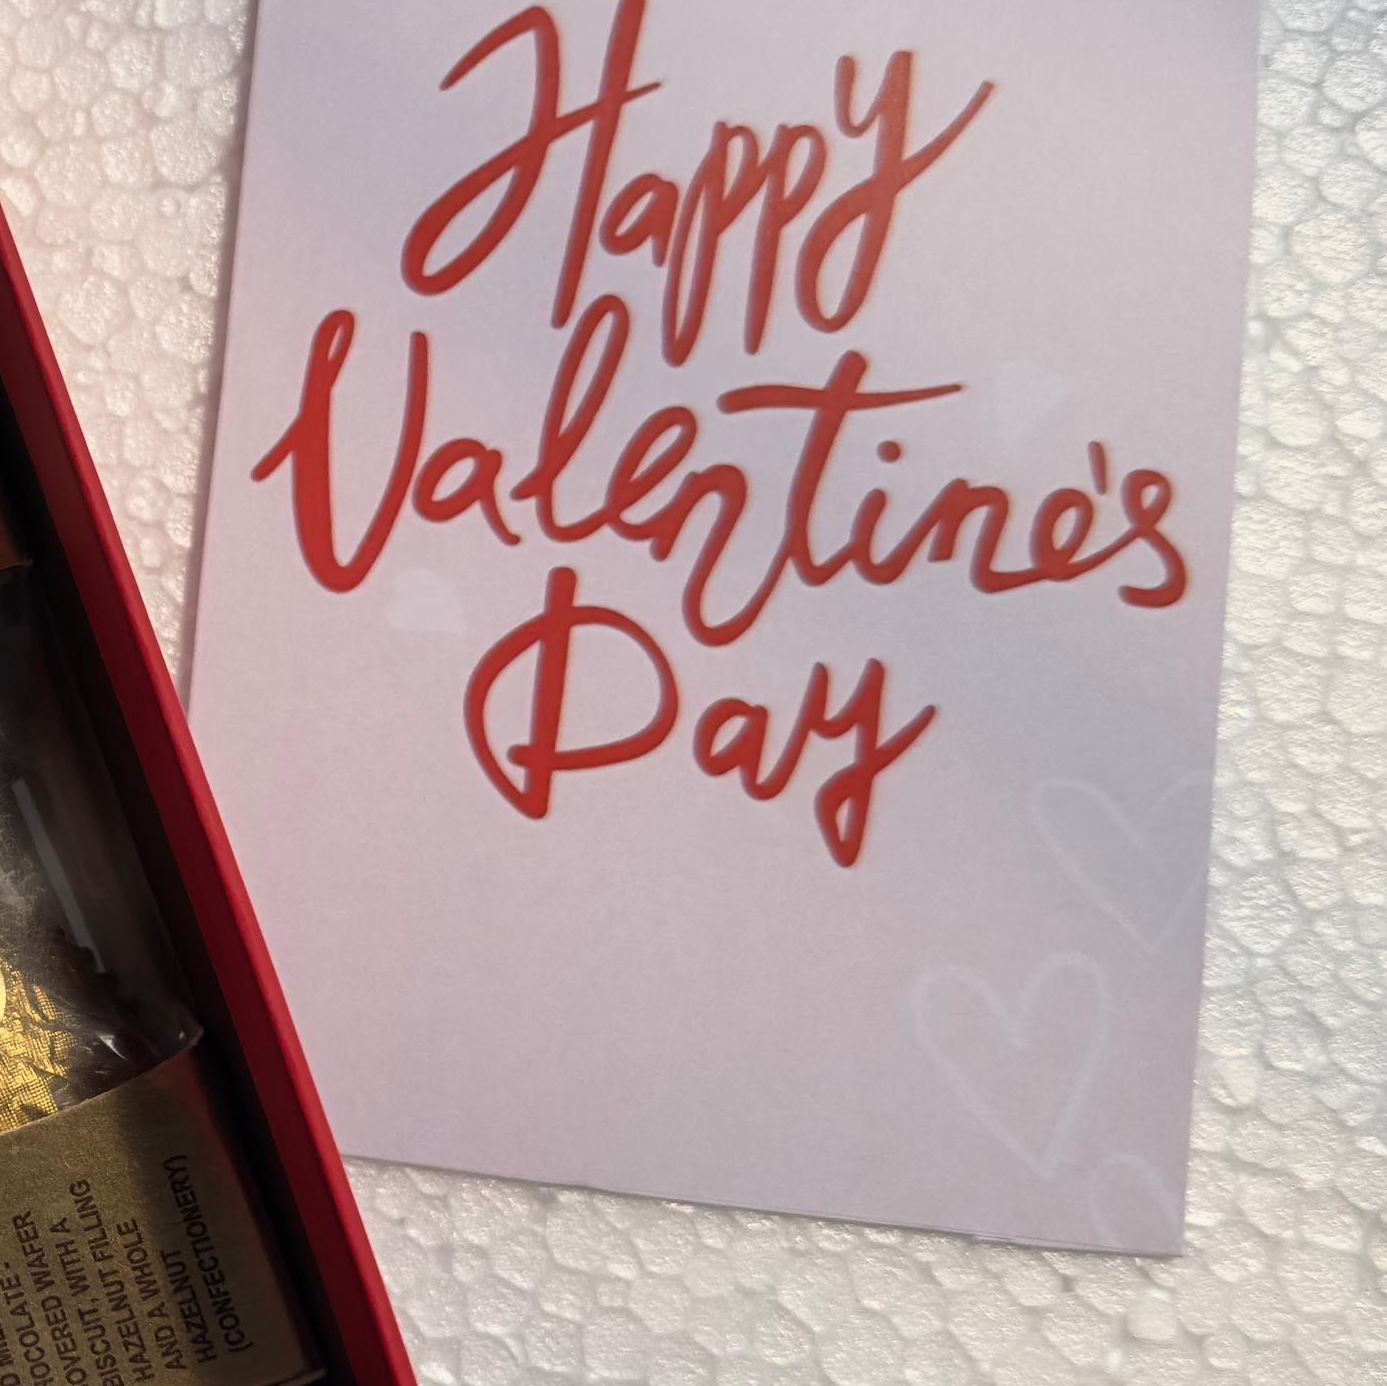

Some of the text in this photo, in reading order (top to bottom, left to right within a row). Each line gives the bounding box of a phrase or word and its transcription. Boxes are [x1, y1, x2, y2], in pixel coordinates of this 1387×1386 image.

[249, 294, 1187, 647] Valentine's
[463, 567, 937, 868] Day
[12, 1210, 55, 1293] WAFER
[49, 1217, 72, 1234] A
[55, 1238, 90, 1297] WITH
[68, 1179, 155, 1383] HAZELNUT FILLING
[116, 1218, 188, 1372] AND A WHOLE
[163, 1155, 254, 1353] (CONFECTIONERY)
[160, 1249, 218, 1365] HAZELNUT
